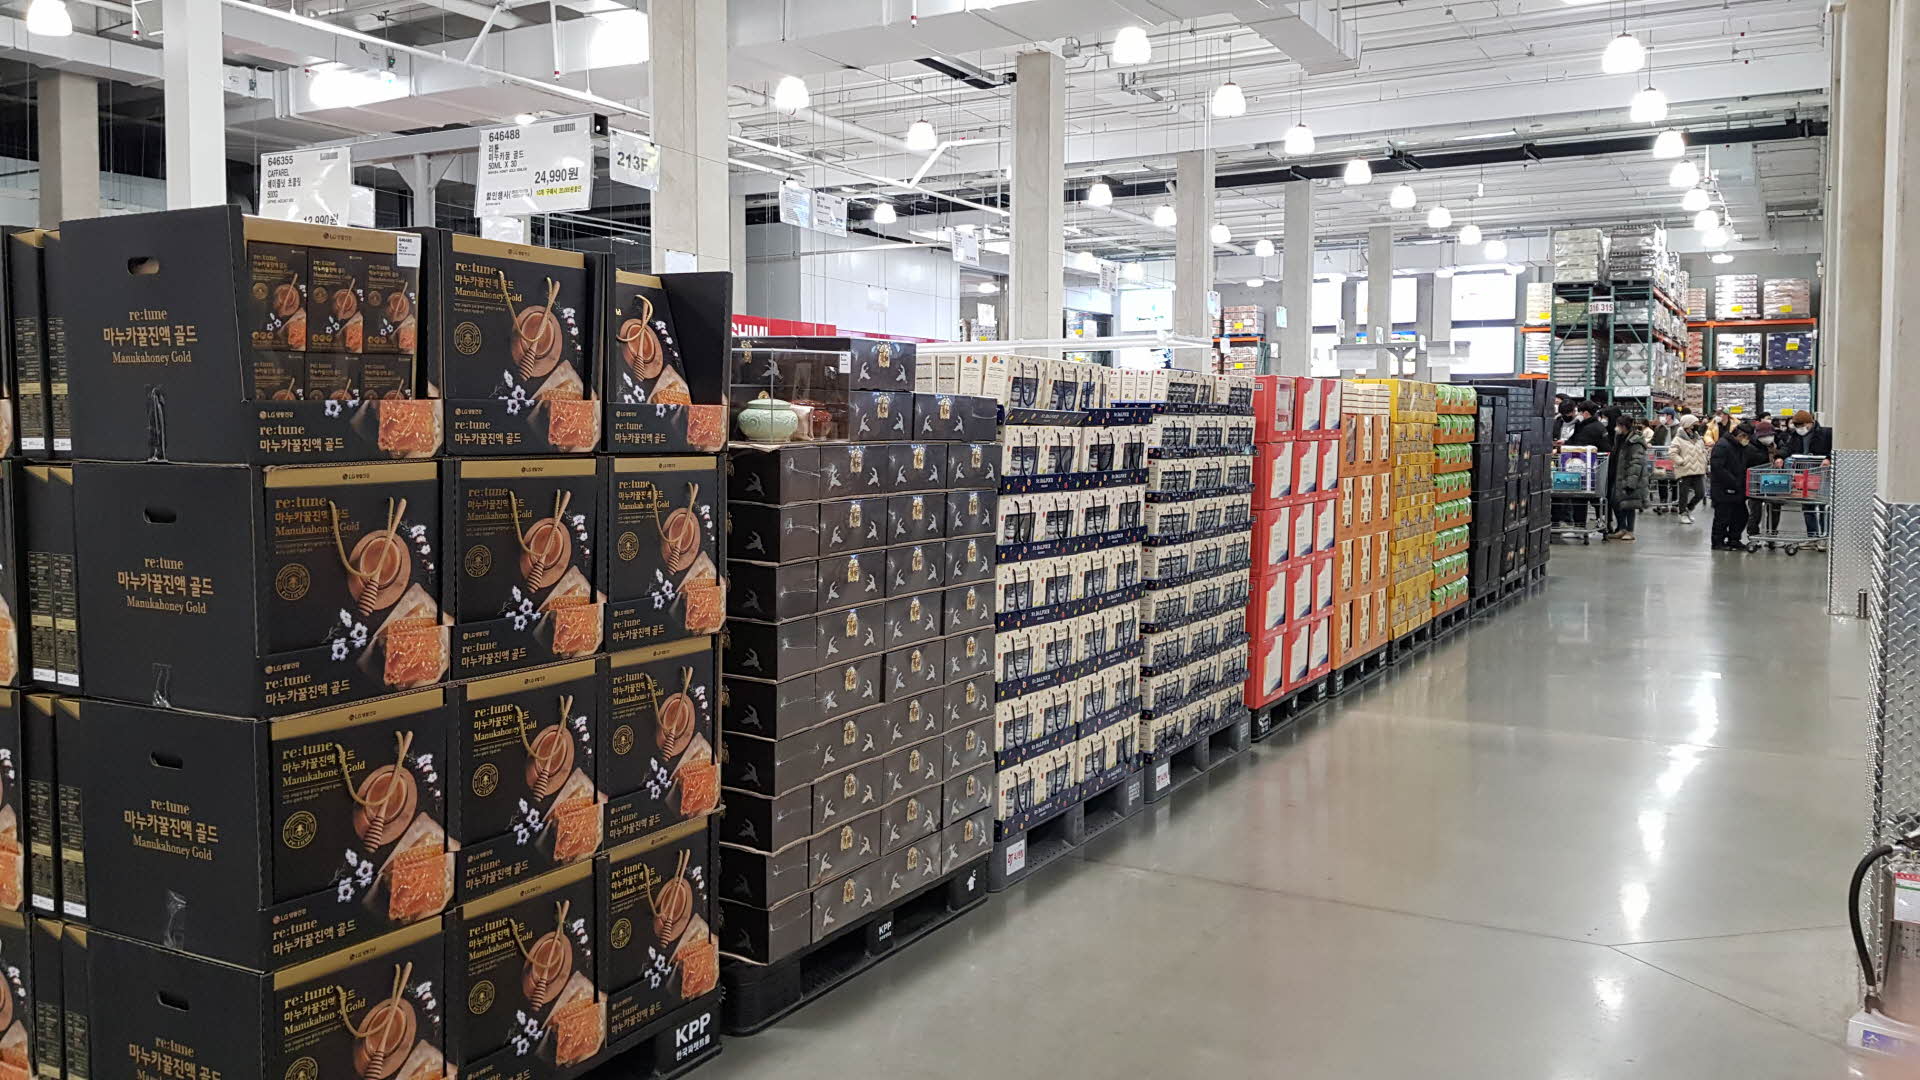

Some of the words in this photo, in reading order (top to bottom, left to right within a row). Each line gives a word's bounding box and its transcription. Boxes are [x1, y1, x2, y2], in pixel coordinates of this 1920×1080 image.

[488, 129, 520, 142] 646488
[267, 155, 294, 166] 646355
[510, 160, 518, 168] 30
[617, 152, 648, 172] 213F
[534, 167, 579, 185] 24,990원
[455, 262, 497, 275] re:tune
[128, 308, 168, 321] re:tune
[1600, 303, 1614, 312] 315
[103, 326, 171, 347] 마누카꿀진액
[174, 324, 198, 346] 골드
[112, 352, 170, 367] Manukahoney
[171, 350, 192, 363] Gold
[260, 424, 304, 436] re:tune
[455, 420, 490, 430] re:tune
[615, 420, 644, 430] re:tune
[260, 438, 322, 454] 마누카꿀진액
[324, 437, 344, 452] 골드
[455, 433, 504, 445] 마누카꿀진액
[506, 432, 522, 444] 골드
[615, 434, 652, 444] 마누카꿀진액
[654, 433, 666, 443] 골드
[618, 480, 650, 489] re:tune
[275, 496, 326, 509] re:tune
[144, 556, 184, 570] re:tune
[118, 571, 186, 597] 마누카꿀진액
[190, 576, 214, 598] 골드
[126, 595, 184, 615] Manukahoney
[186, 601, 206, 614] Gold
[612, 626, 651, 642] 마누카꿀진액
[652, 624, 664, 636] 골드
[613, 619, 640, 630] re:tune
[462, 640, 498, 654] re:tune
[461, 650, 510, 668] 마누카꿀진액
[511, 648, 527, 661] 골드
[265, 673, 312, 690] re:tune
[265, 683, 328, 706] 마누카꿀진액
[330, 679, 350, 694] 골드
[474, 703, 514, 718] re:tune
[282, 742, 334, 760] re:tune
[150, 799, 190, 816] re:tune
[124, 810, 193, 842] 마누카꿀진액
[196, 822, 219, 844] 골드
[610, 812, 638, 827] re:tune
[132, 834, 190, 860] Manukahoney
[192, 846, 212, 861] Gold
[466, 859, 501, 877] re:tune
[466, 867, 512, 890] 마누카꿀진액
[514, 860, 529, 875] 골드
[272, 918, 318, 941] re:tune
[468, 917, 508, 938] re:tune
[878, 921, 892, 936] KPP
[272, 928, 334, 956] 마누카꿀진액
[337, 920, 358, 937] 골드
[284, 984, 334, 1009] re:tune
[346, 998, 367, 1014] Gold
[676, 1012, 711, 1048] KPP
[155, 1036, 195, 1058] re:tune
[128, 1044, 196, 1080] 마누카꿀진액
